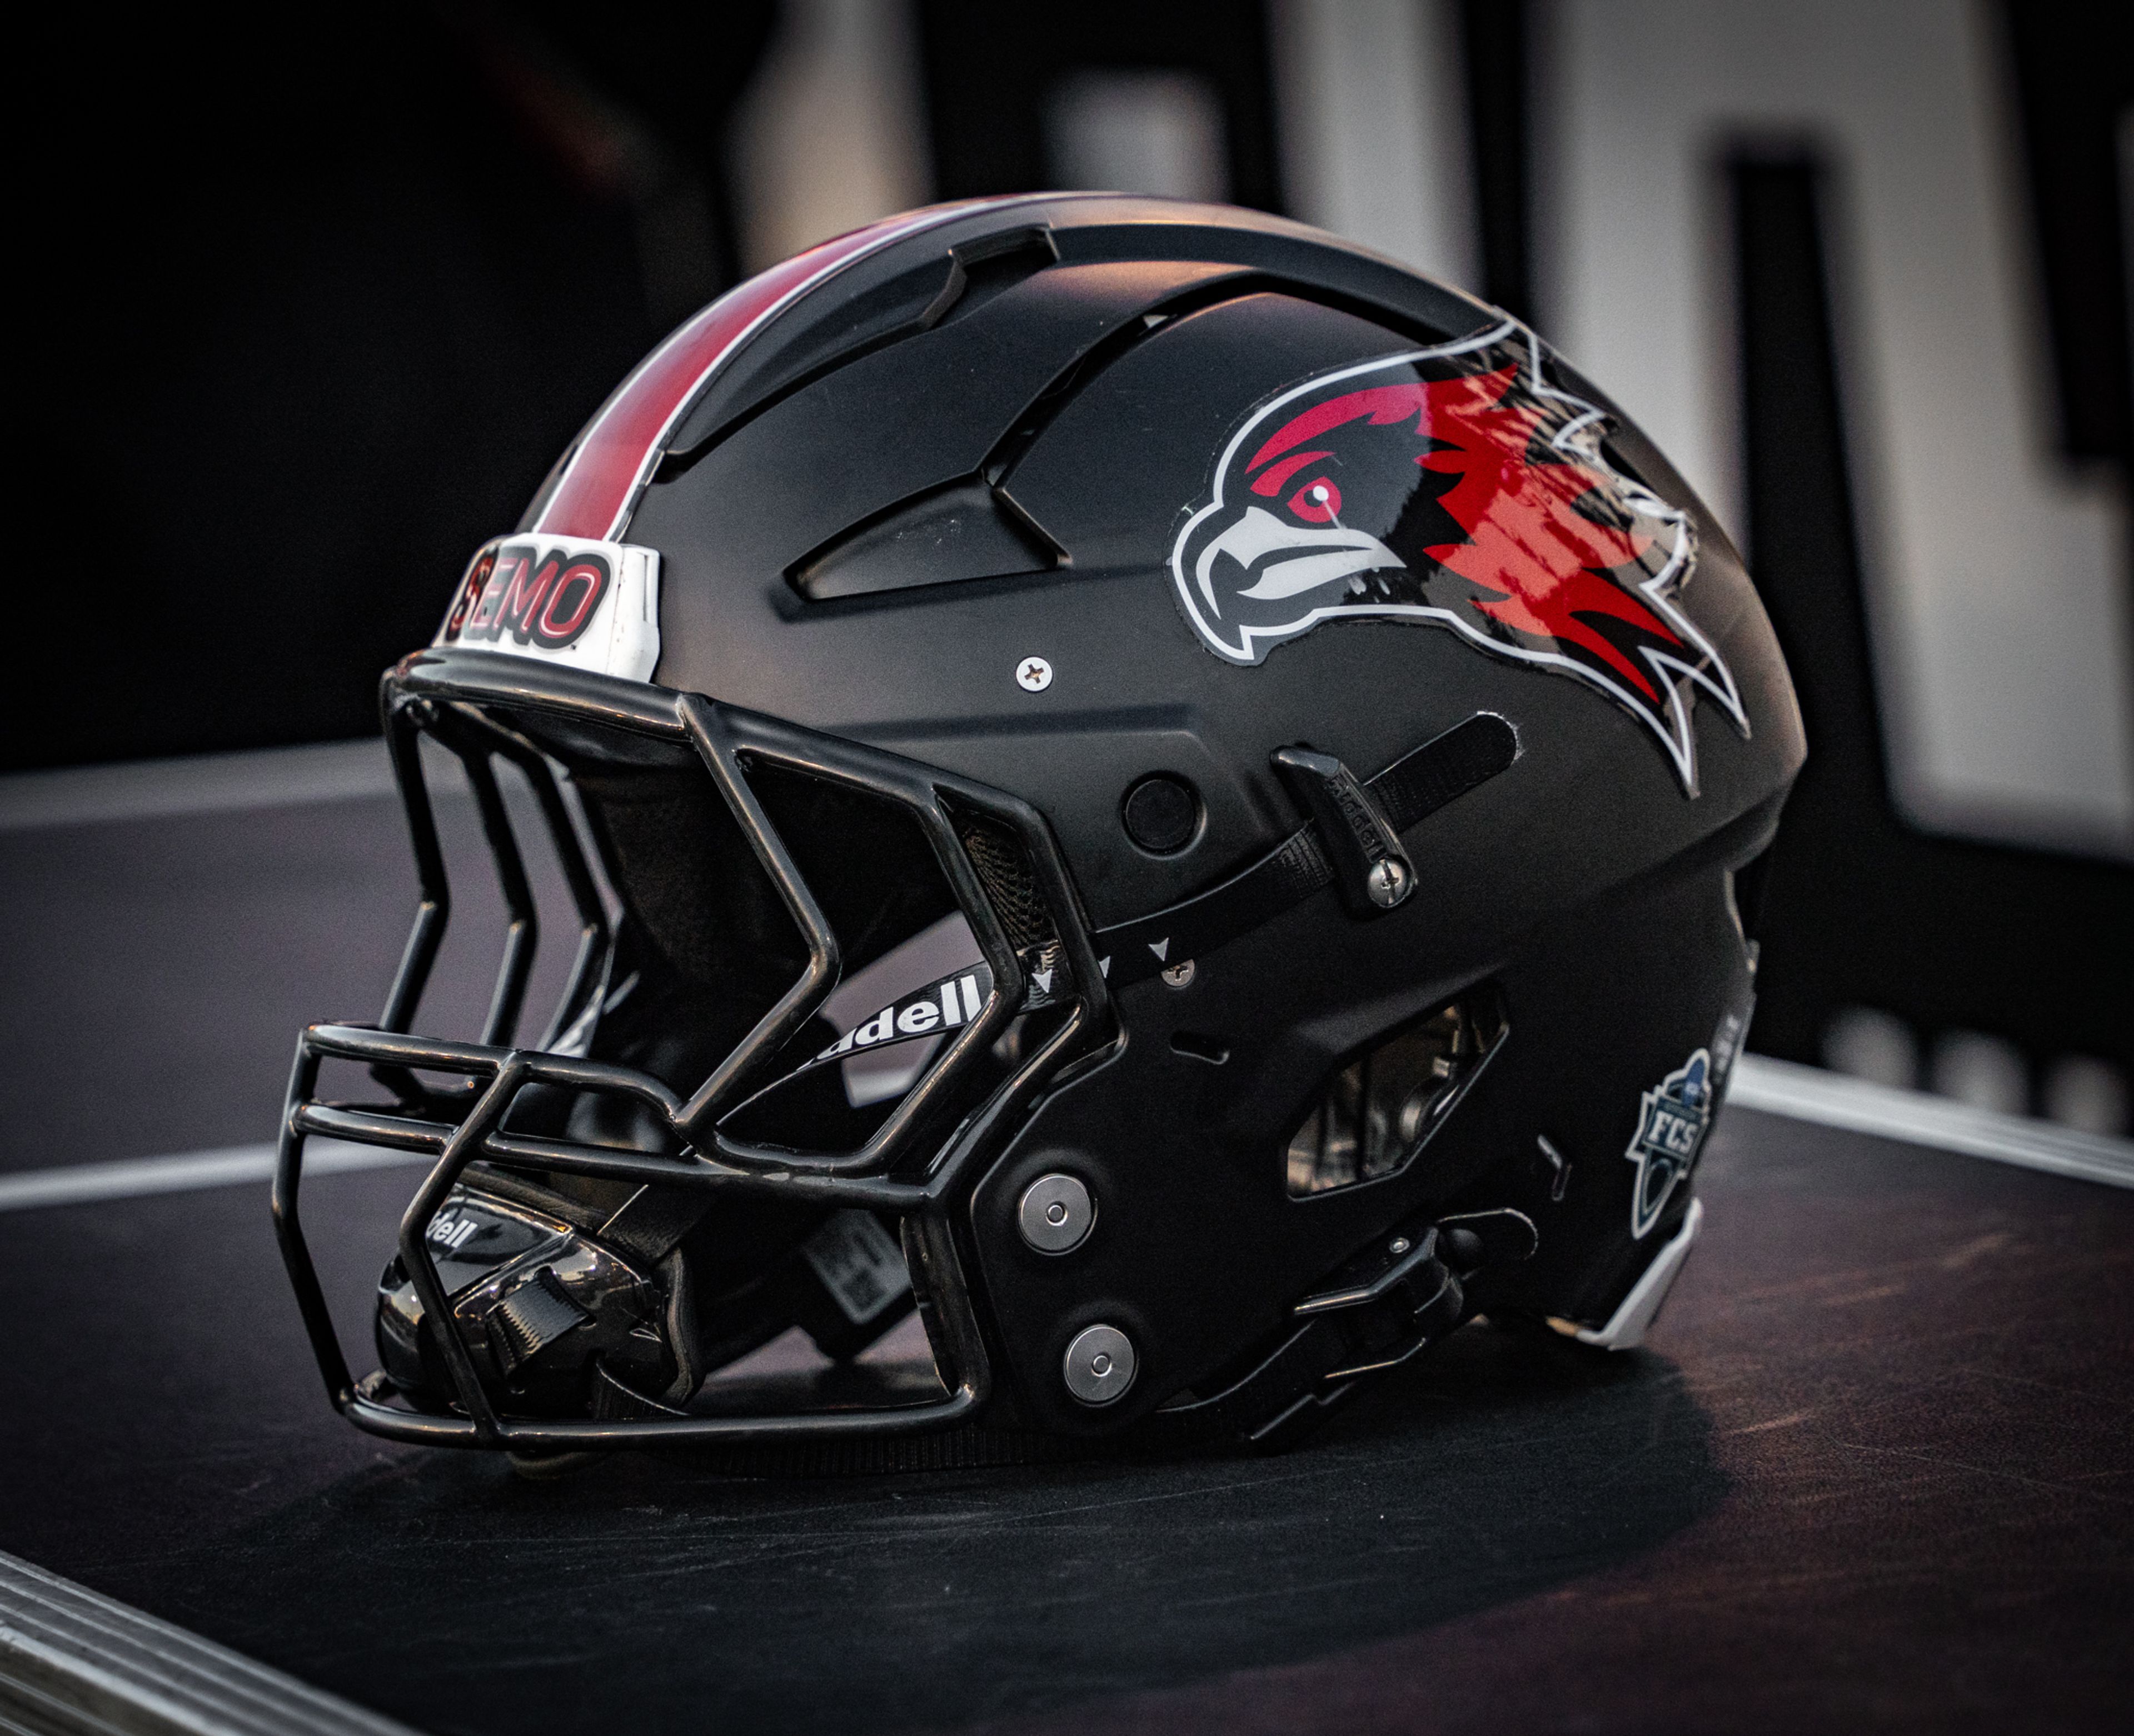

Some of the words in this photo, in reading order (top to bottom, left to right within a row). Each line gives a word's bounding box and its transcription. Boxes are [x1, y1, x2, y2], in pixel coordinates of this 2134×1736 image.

[446, 545, 611, 649] SEMO
[1648, 1110, 1698, 1154] FCS
[426, 1211, 478, 1248] dell
